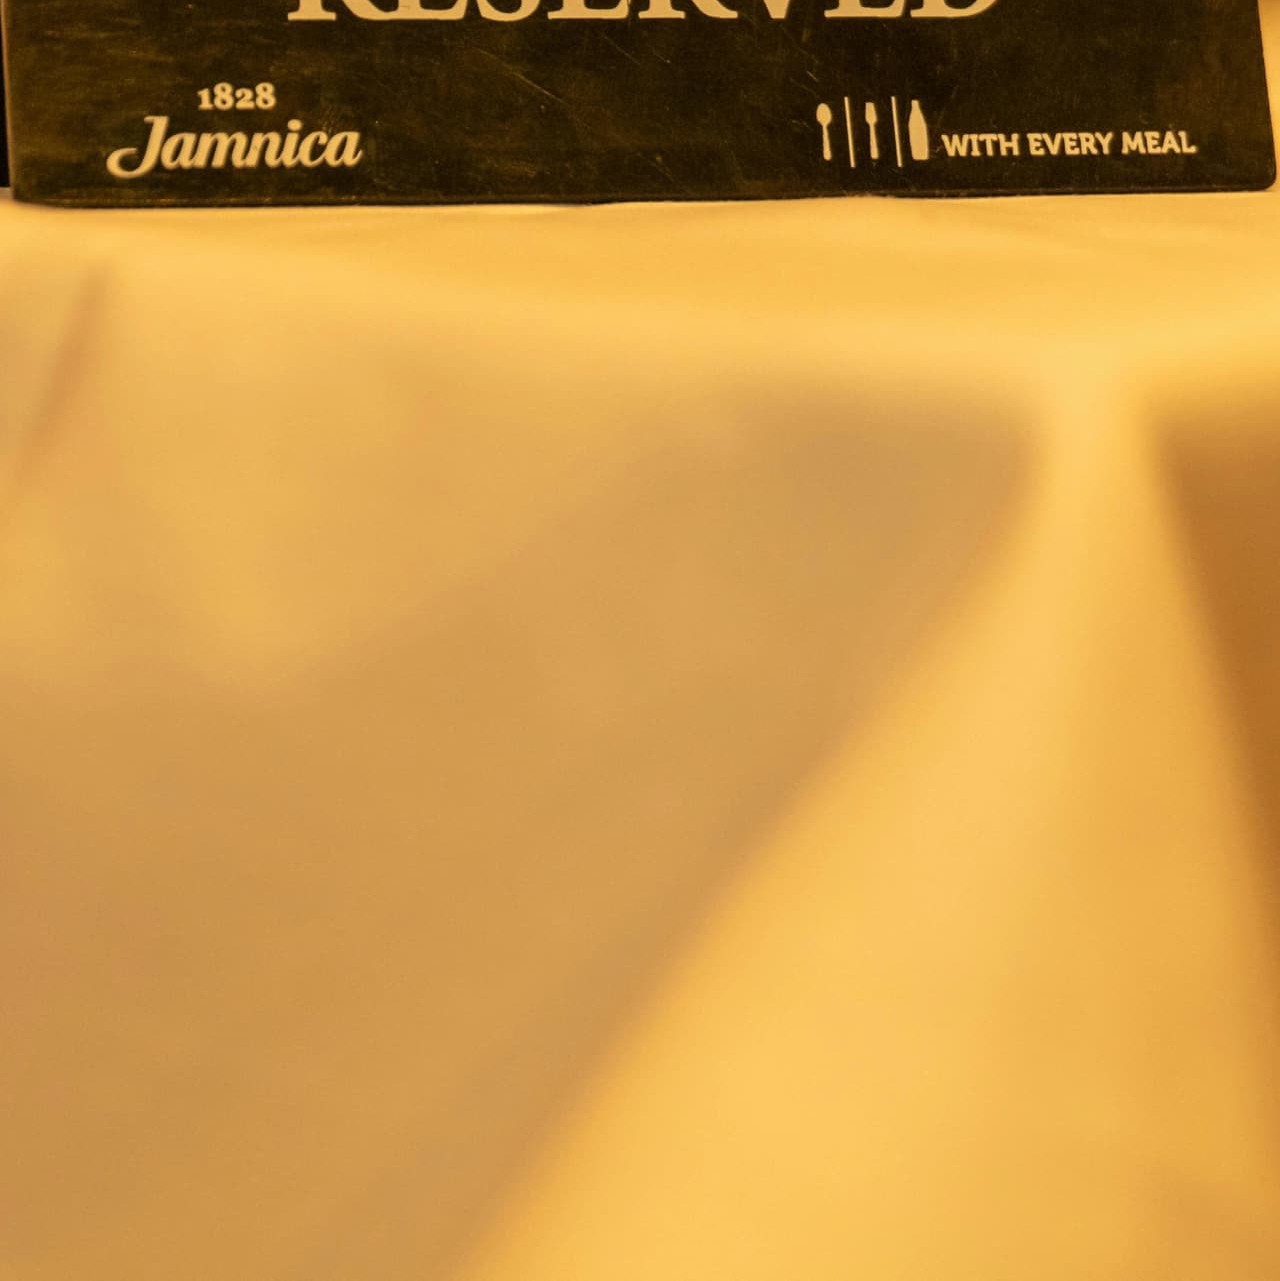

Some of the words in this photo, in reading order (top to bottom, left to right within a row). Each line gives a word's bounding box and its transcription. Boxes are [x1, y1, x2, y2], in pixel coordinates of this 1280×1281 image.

[197, 82, 277, 111] 1828
[106, 115, 364, 179] Jamnica
[940, 131, 1020, 157] WITH
[1026, 131, 1114, 156] EVERY
[1121, 130, 1198, 155] MEAL
